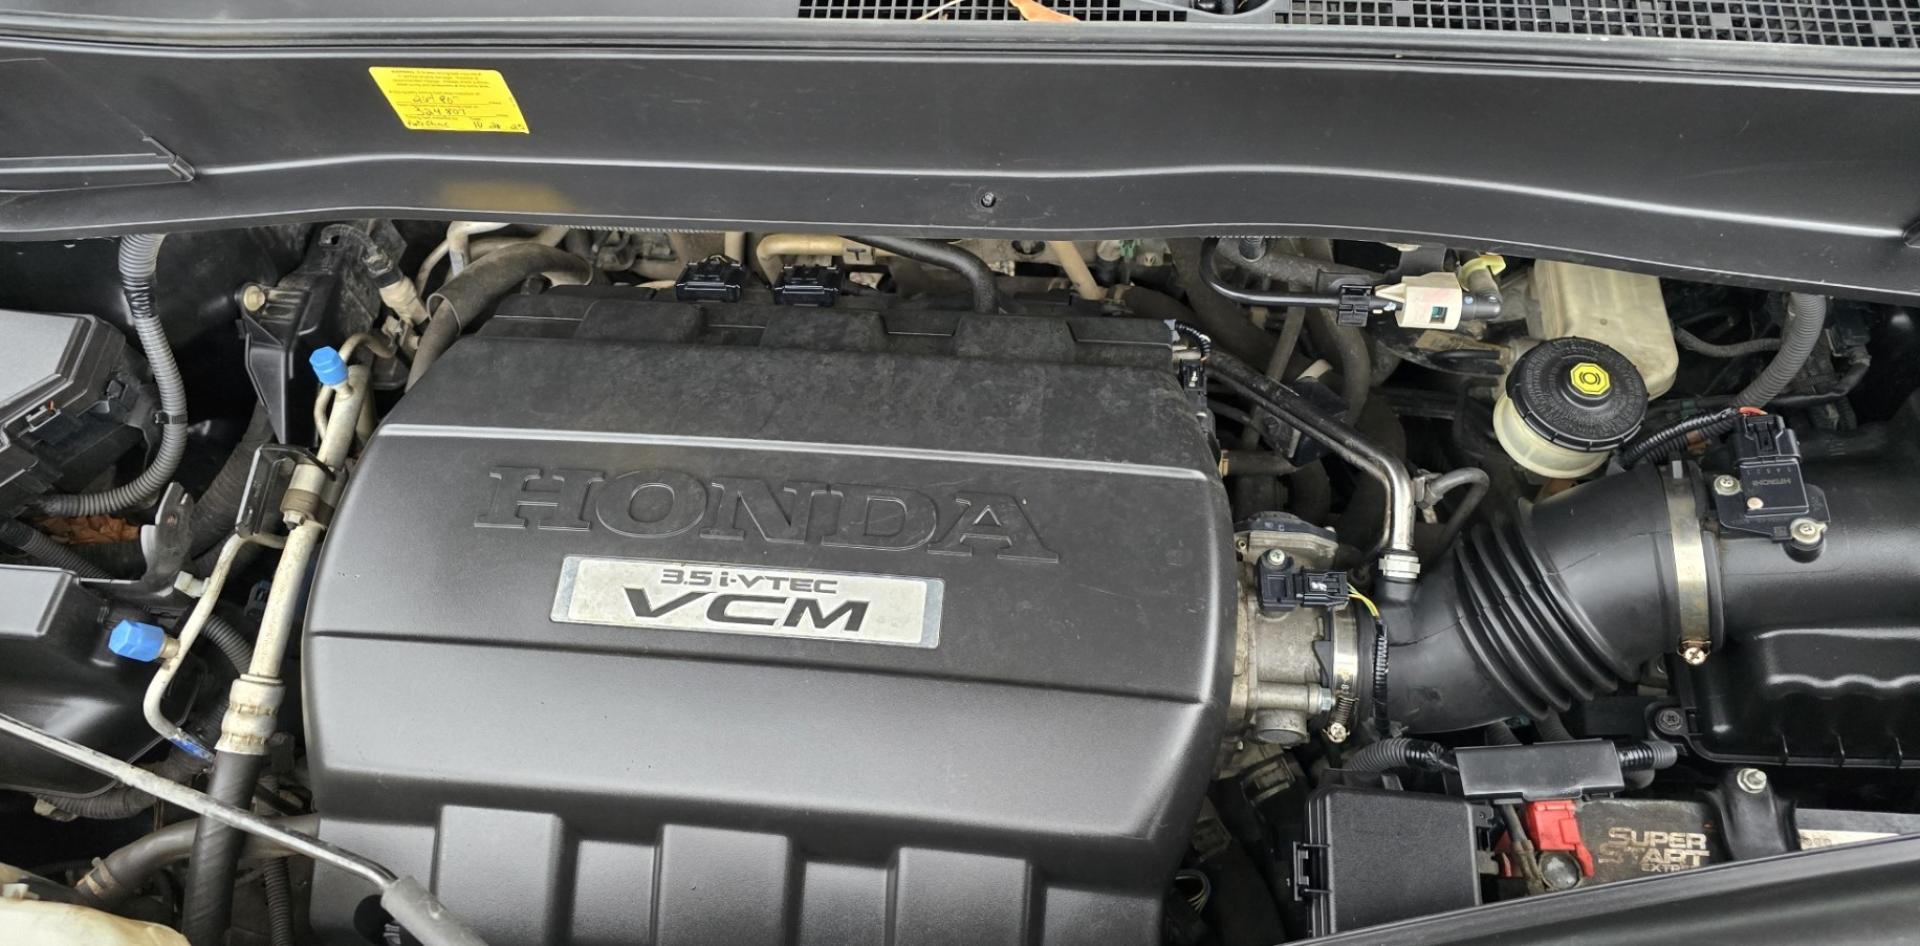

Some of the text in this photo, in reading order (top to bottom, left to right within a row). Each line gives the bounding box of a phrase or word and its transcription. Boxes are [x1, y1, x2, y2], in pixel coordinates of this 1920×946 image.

[473, 465, 1060, 564] HONDA
[661, 568, 712, 587] 3.5
[624, 587, 870, 632] VCM
[1608, 826, 1707, 850] SUPER
[1597, 843, 1711, 867] START
